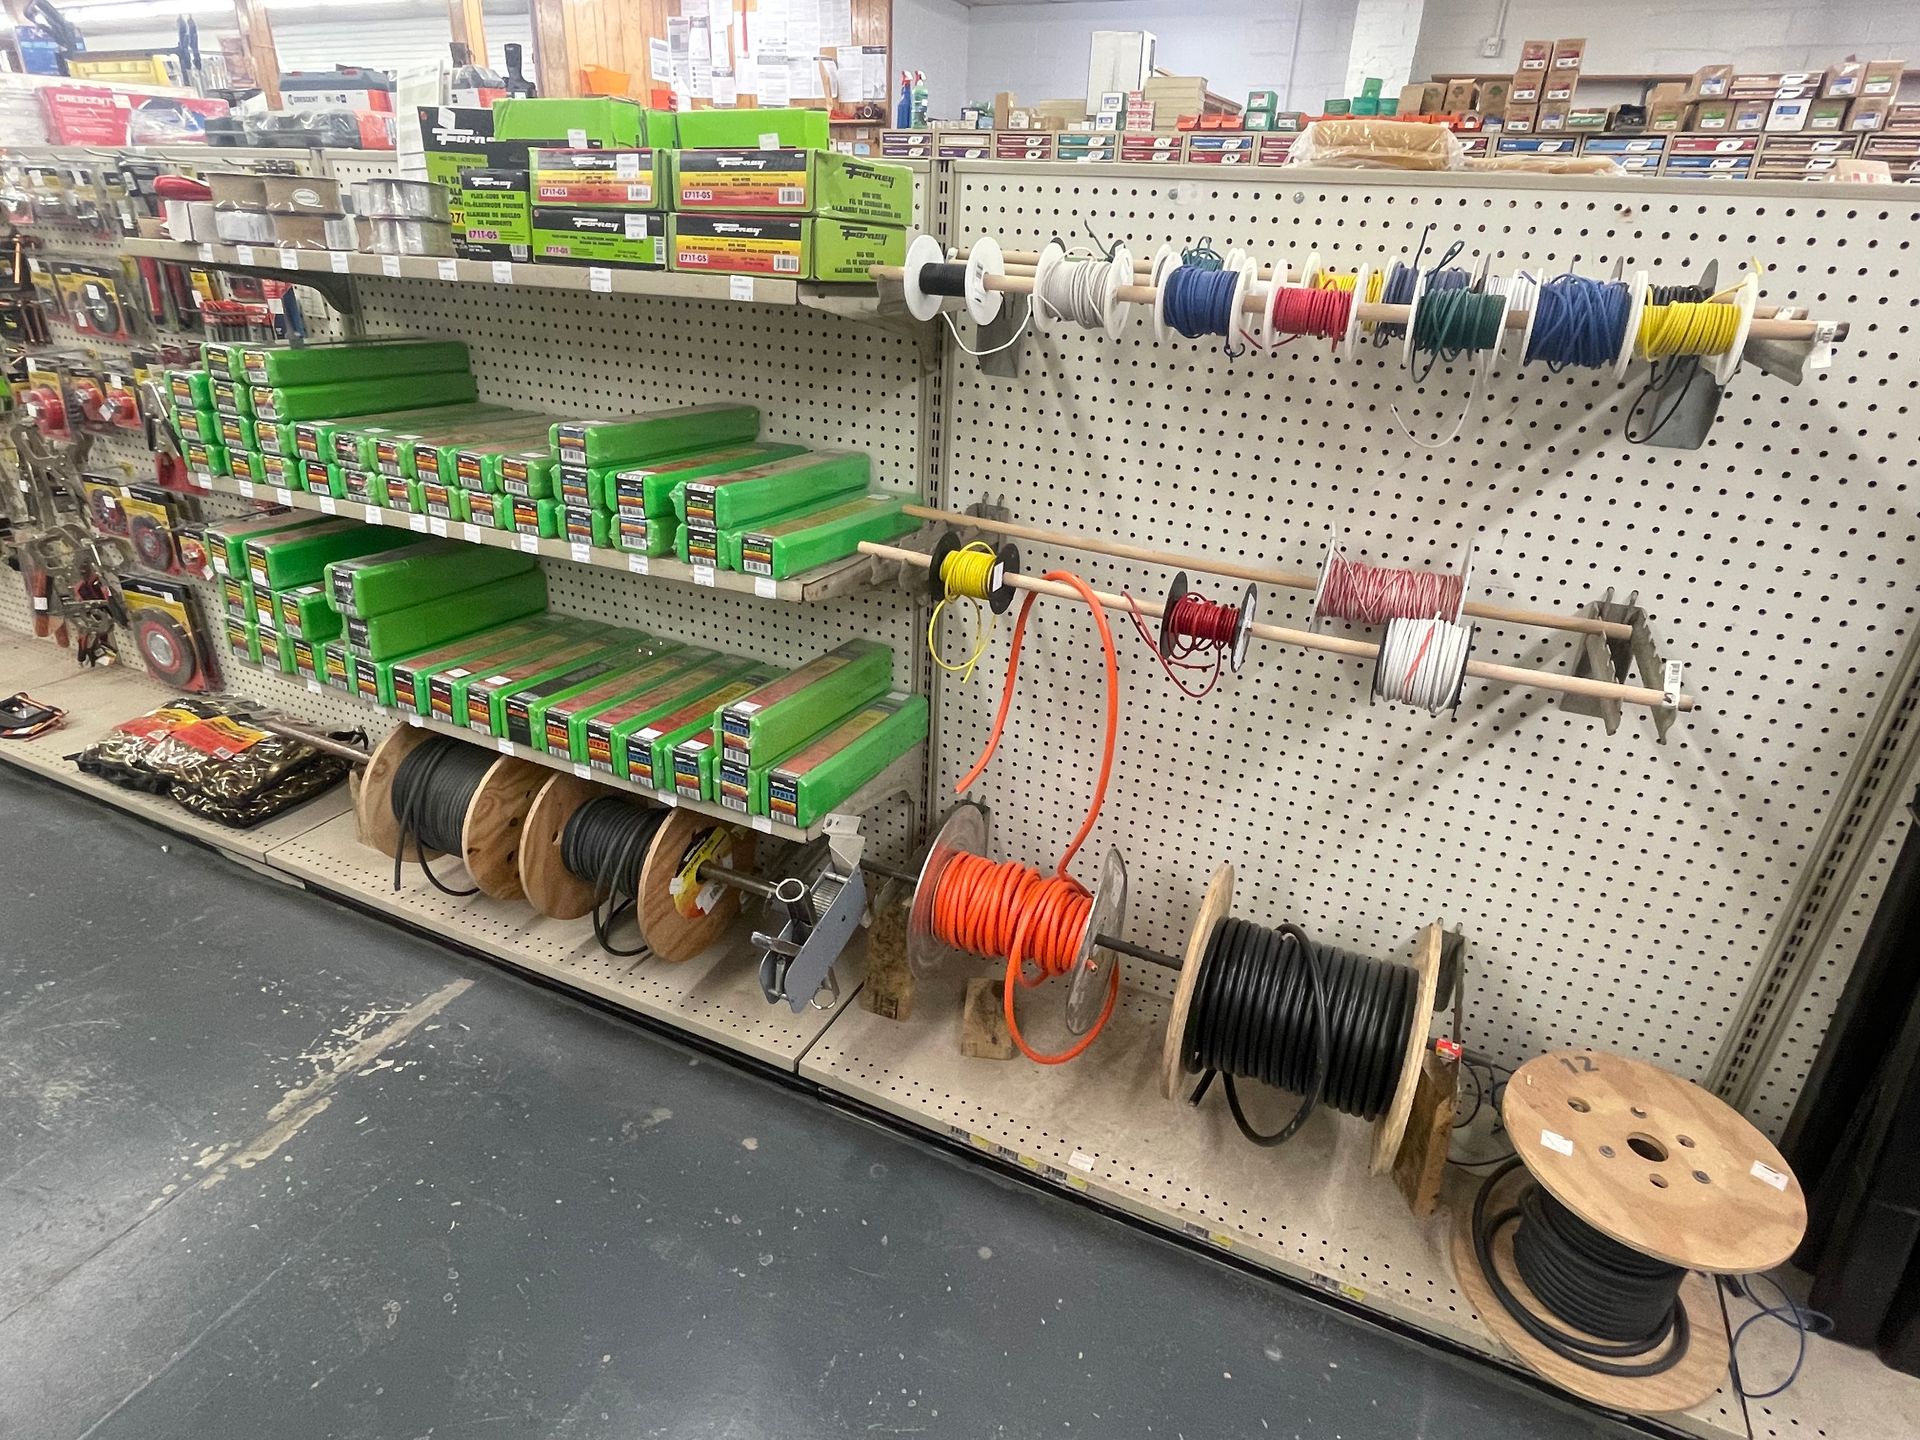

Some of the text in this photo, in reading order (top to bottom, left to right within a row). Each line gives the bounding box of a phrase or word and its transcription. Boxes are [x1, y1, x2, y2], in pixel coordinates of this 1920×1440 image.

[842, 162, 895, 189] Forney
[684, 191, 711, 199] E71T-GS
[468, 230, 498, 240] E71T-GS
[840, 225, 887, 246] Forney
[680, 253, 707, 262] E71T-GS
[1559, 1056, 1600, 1074] 12
